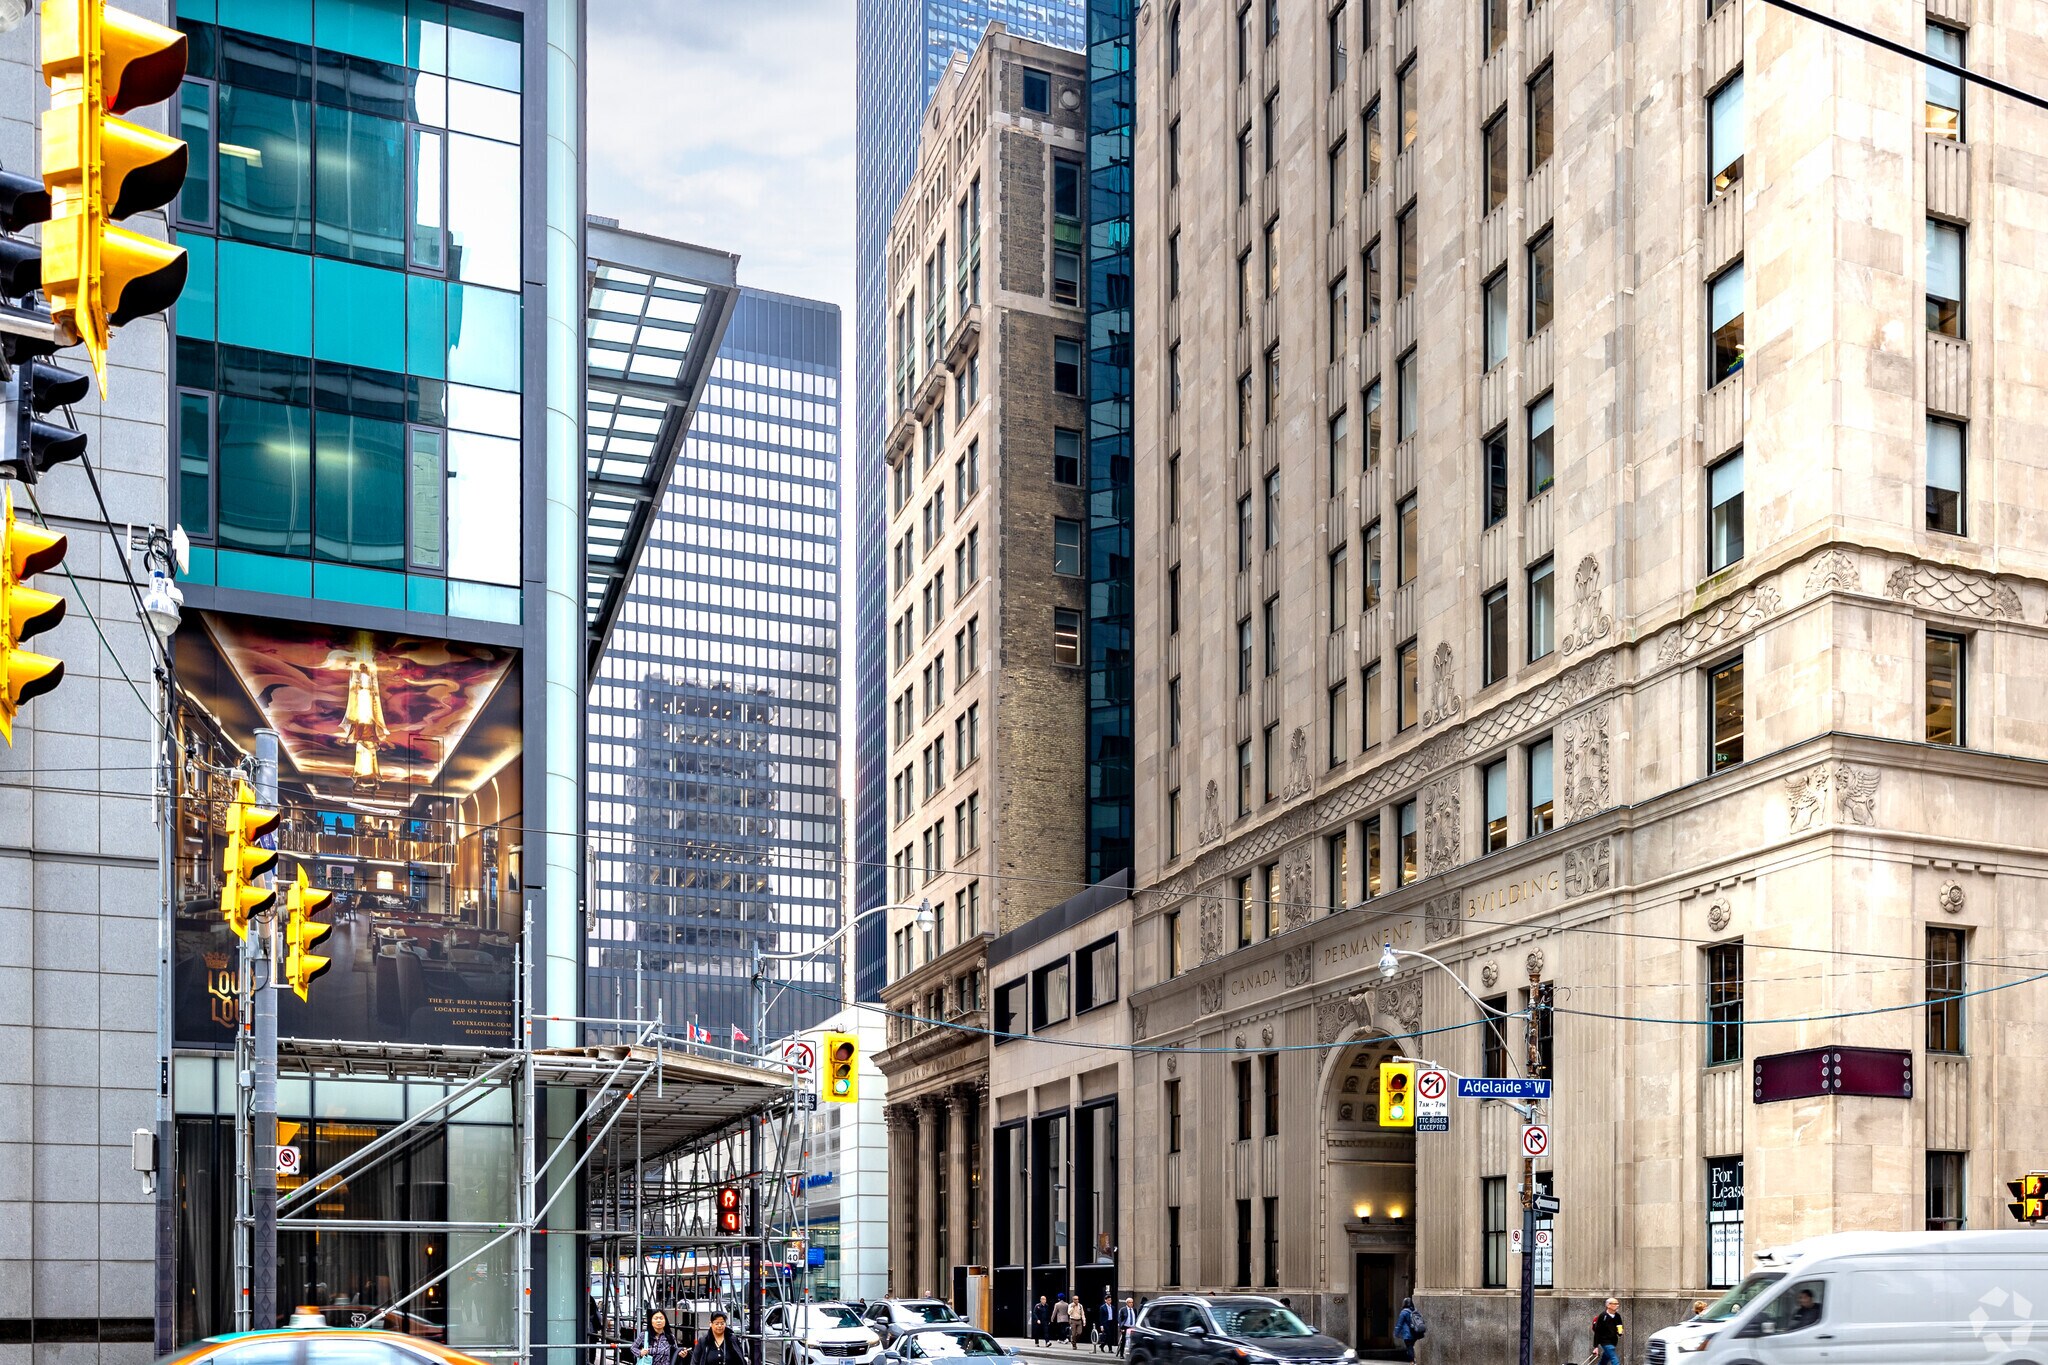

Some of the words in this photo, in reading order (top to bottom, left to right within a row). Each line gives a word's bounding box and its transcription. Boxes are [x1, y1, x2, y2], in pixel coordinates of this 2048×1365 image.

[1231, 967, 1278, 996] CANADA
[1324, 920, 1413, 966] PERMANENT
[1468, 870, 1559, 918] BVILDING
[452, 1020, 512, 1028] LOUIXLOUIS.COM
[904, 1067, 920, 1084] BANK
[922, 1063, 930, 1076] OF
[1463, 1080, 1522, 1094] Adelaide
[1525, 1081, 1532, 1089] St
[1534, 1081, 1546, 1095] W
[1418, 1100, 1430, 1108] 7AM
[1435, 1100, 1446, 1108] 7PM
[1712, 1167, 1733, 1184] For
[1712, 1200, 1727, 1208] Retail
[787, 1253, 798, 1262] 40
